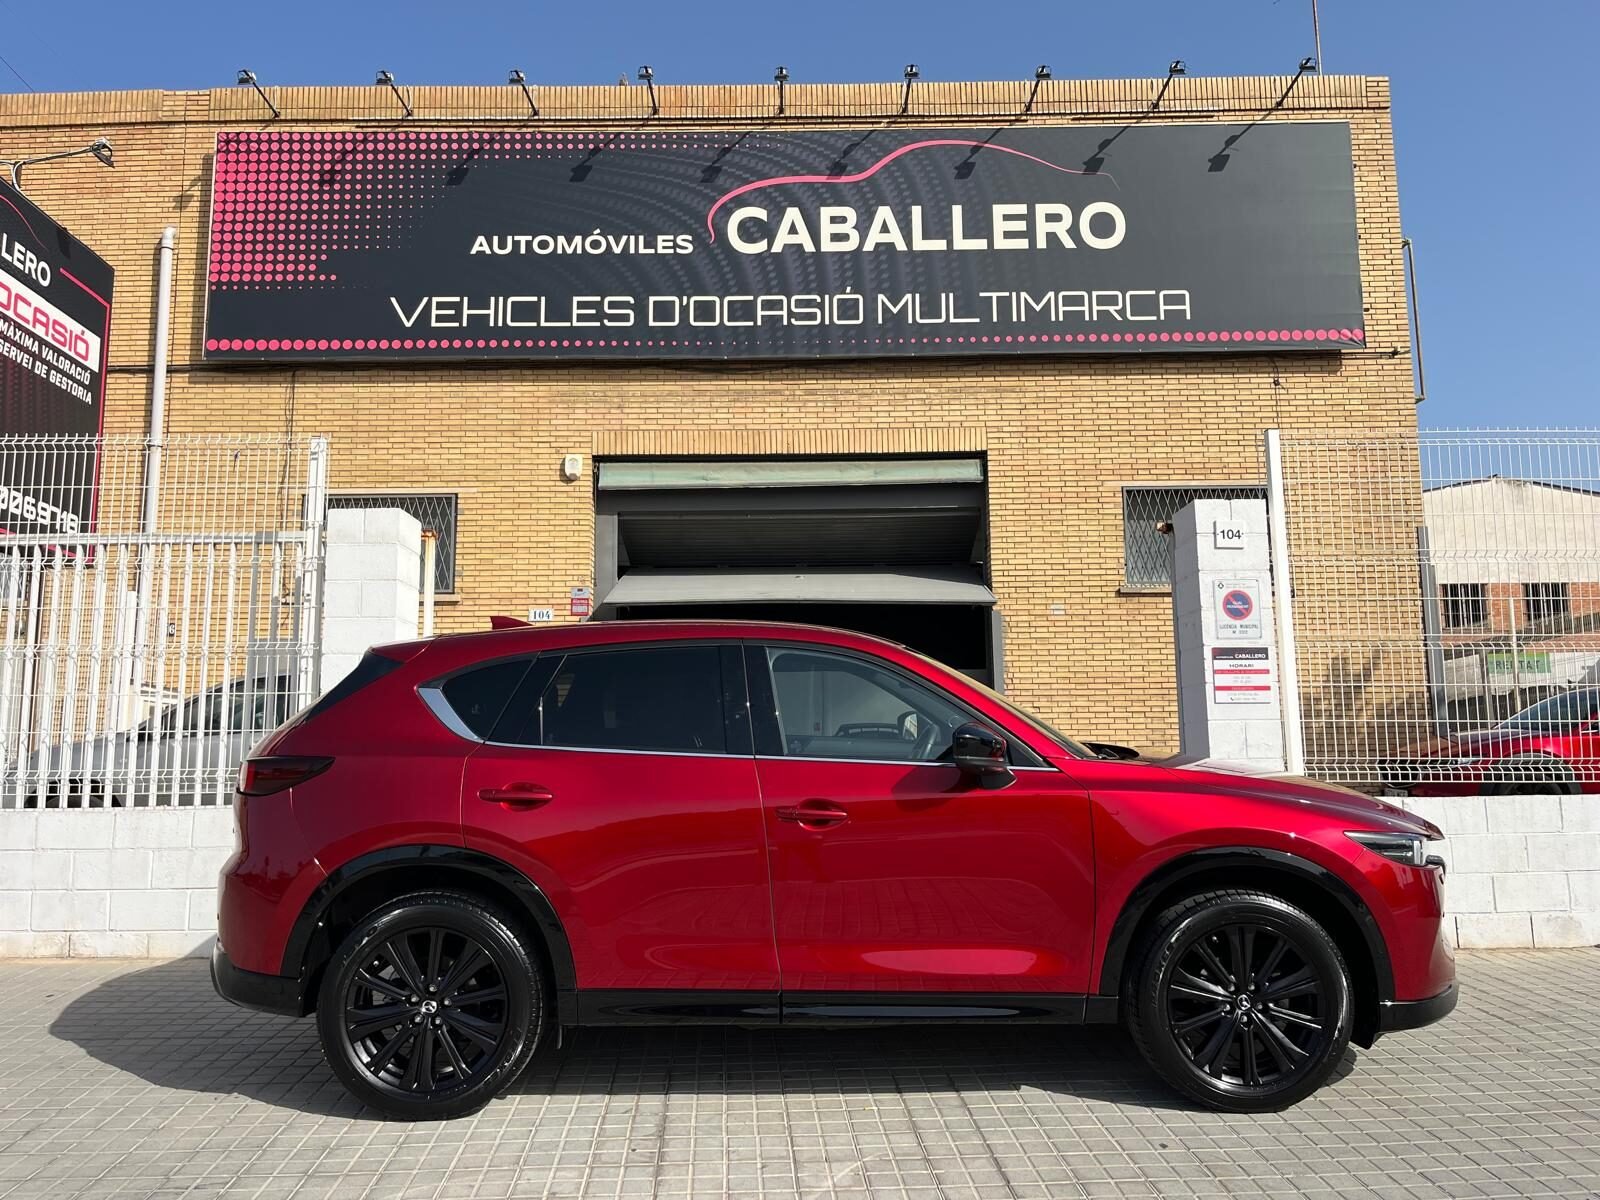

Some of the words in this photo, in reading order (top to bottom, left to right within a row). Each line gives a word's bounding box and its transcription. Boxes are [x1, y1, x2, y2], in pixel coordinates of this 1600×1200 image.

[470, 228, 694, 255] AUTOMÓVILES
[727, 201, 1127, 254] CABALLERO
[390, 296, 635, 328] VEHICLES
[648, 286, 864, 327] D'OCASIÓ
[877, 289, 1191, 325] MULTIMARCA
[34, 360, 49, 379] DE
[49, 370, 92, 405] GESTORIA
[42, 344, 91, 386] VALORACIÓ
[1220, 529, 1242, 540] 104
[533, 610, 550, 620] 104
